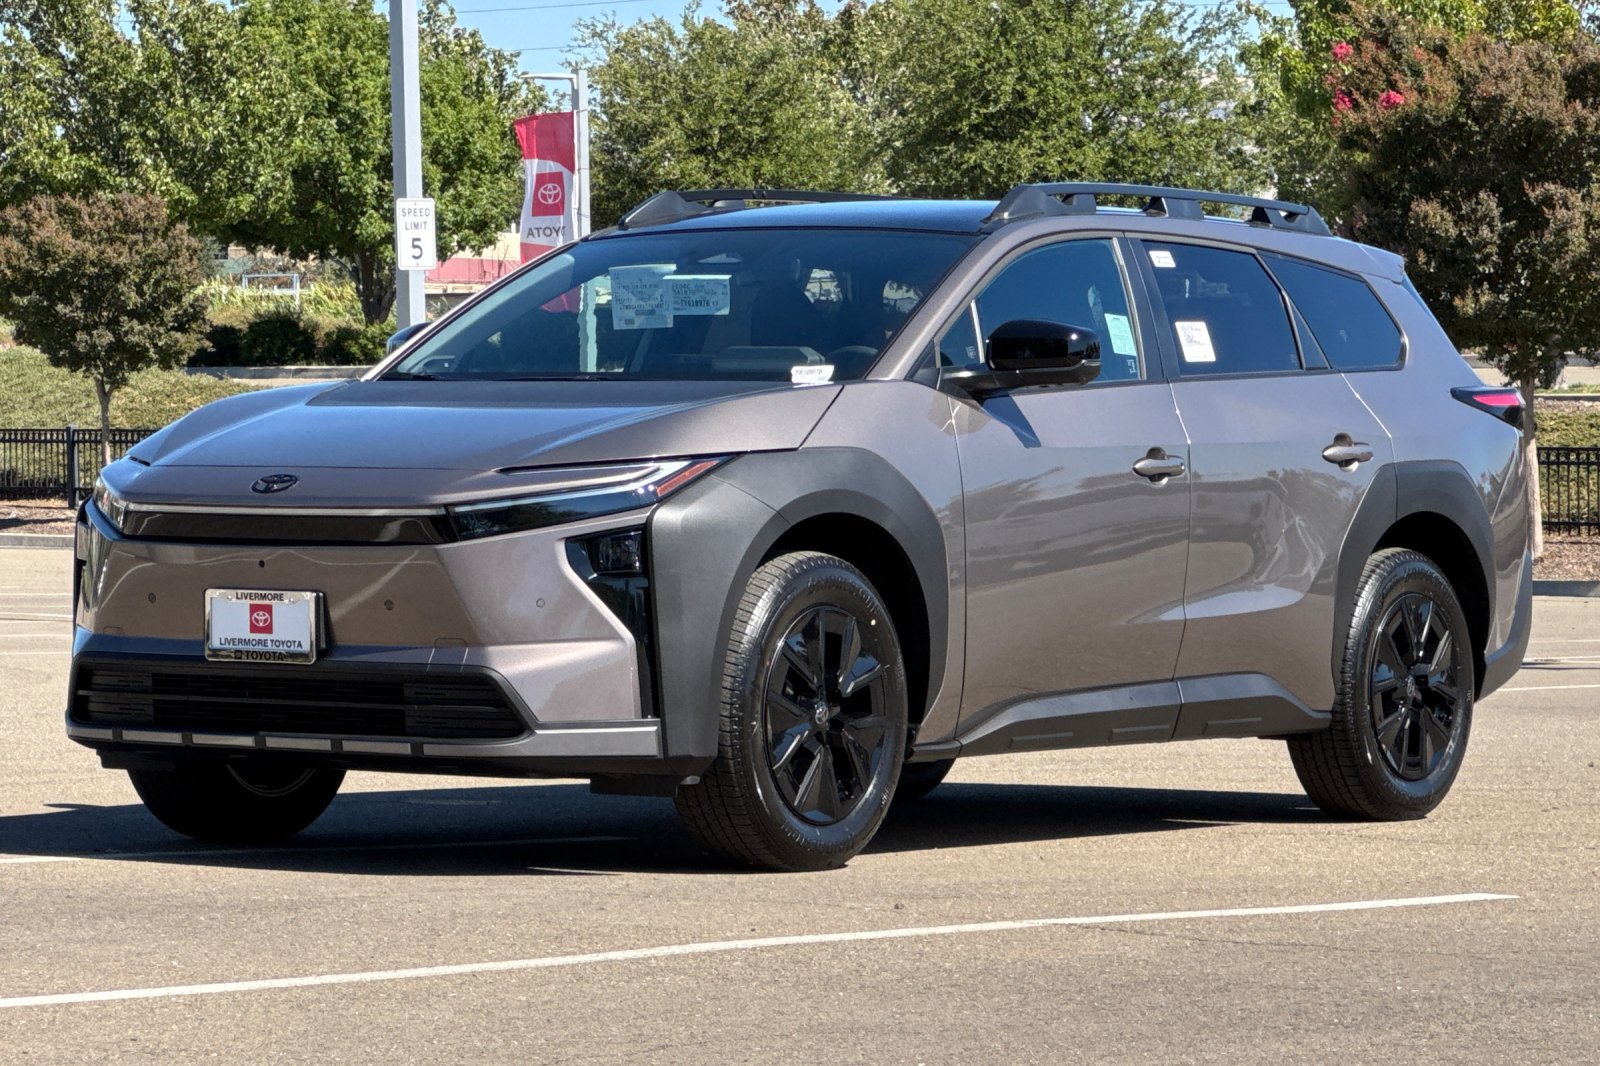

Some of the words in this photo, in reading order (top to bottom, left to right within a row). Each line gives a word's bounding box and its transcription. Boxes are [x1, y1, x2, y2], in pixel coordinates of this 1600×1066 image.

[401, 207, 431, 217] SPEED
[405, 221, 428, 231] LIMIT
[411, 237, 423, 260] 5
[236, 592, 284, 601] LIVERMORE
[219, 637, 269, 647] LIVERMORE
[269, 640, 303, 649] TOYOTA
[245, 651, 284, 661] TOYOTA
